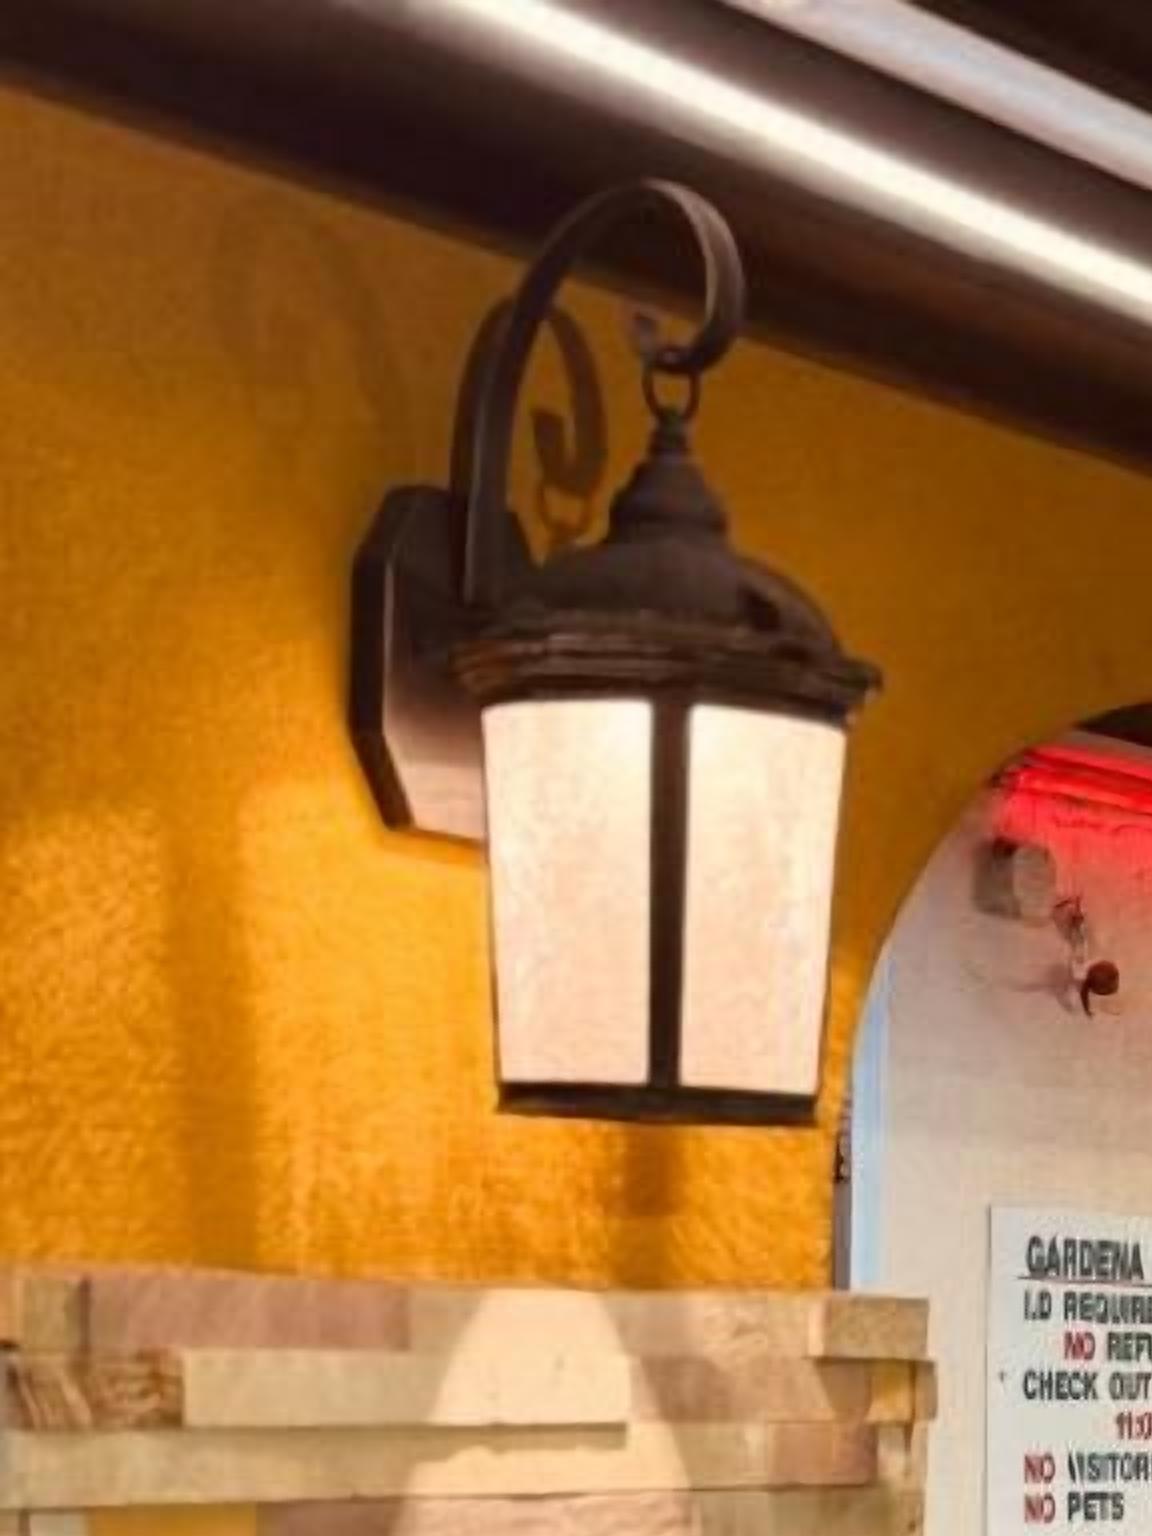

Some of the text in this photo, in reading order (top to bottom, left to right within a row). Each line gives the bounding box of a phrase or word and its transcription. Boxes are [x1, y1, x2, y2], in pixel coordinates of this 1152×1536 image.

[1026, 1235, 1144, 1280] GARDENA
[1064, 1332, 1096, 1360] NO
[1023, 1370, 1098, 1400] CHECK
[1109, 1372, 1152, 1400] OUT
[1024, 1453, 1056, 1484] NO
[1024, 1492, 1124, 1523] NO PETS
